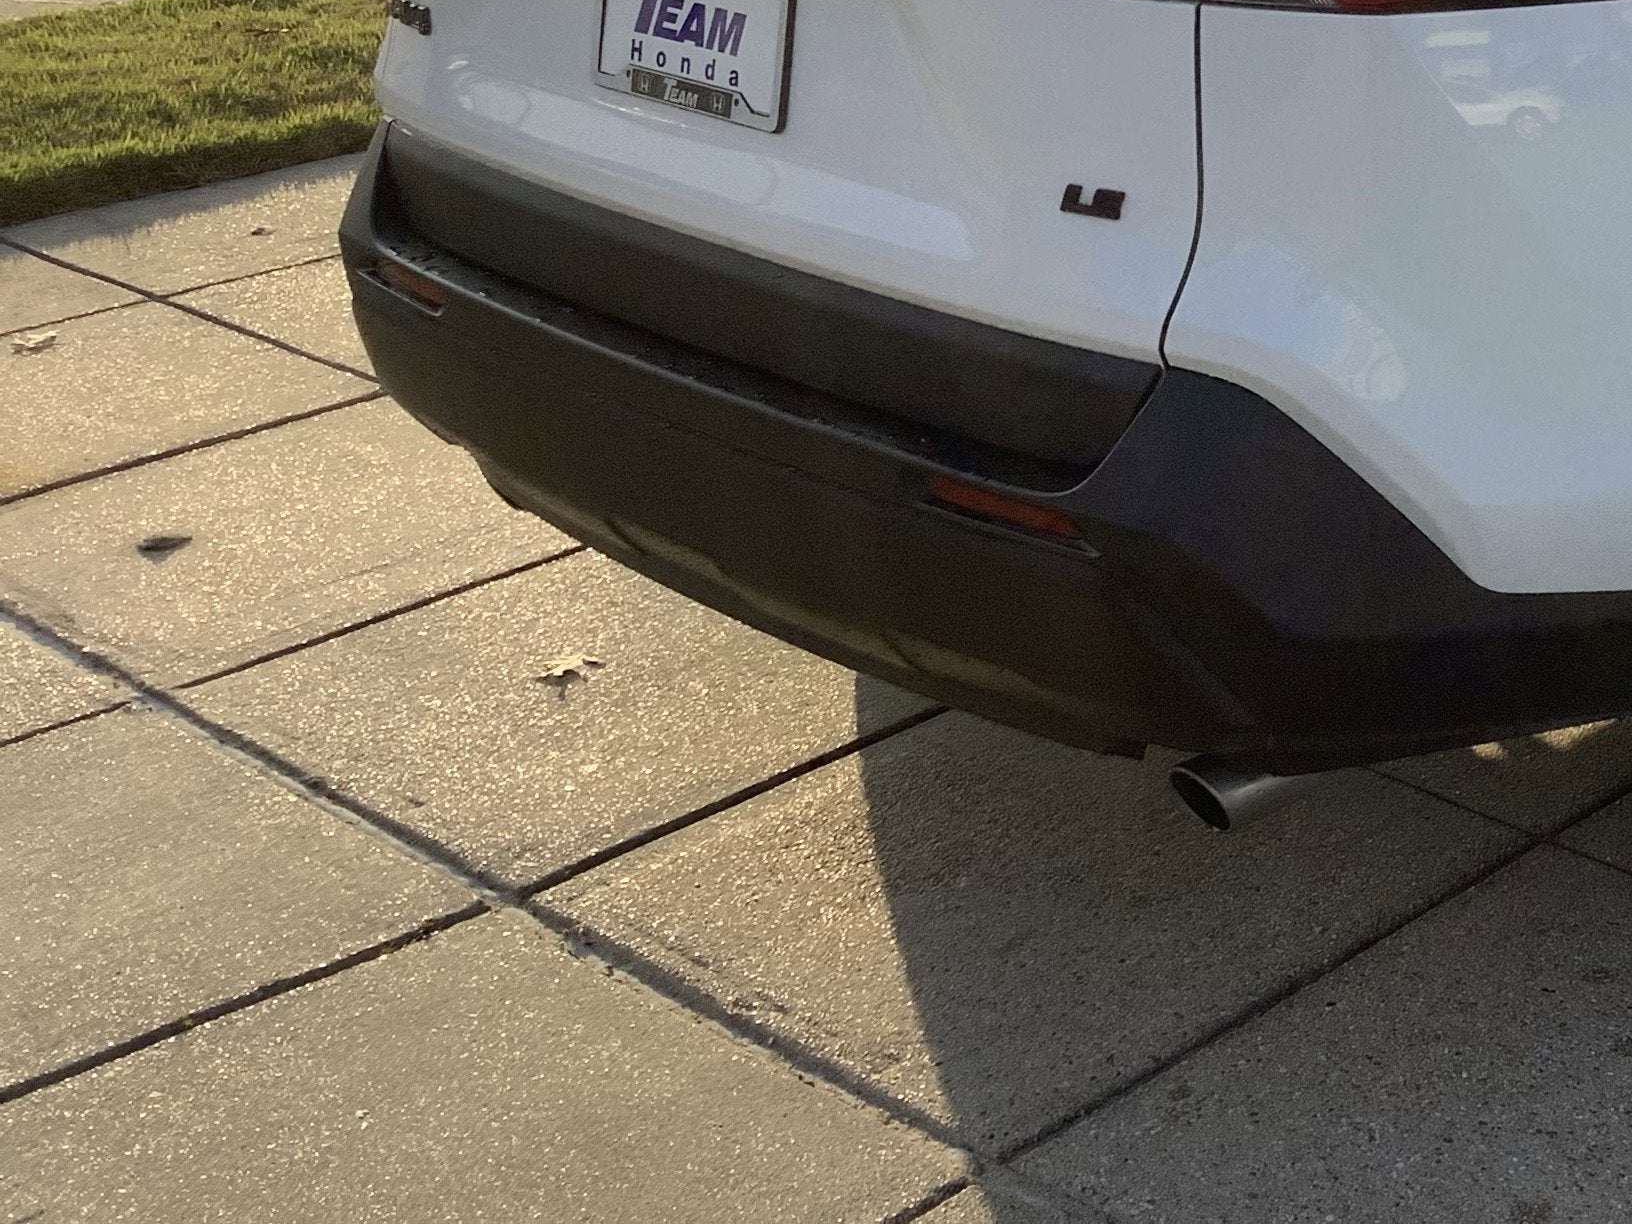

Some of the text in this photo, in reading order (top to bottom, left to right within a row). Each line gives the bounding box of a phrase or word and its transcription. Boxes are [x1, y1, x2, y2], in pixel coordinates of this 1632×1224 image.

[630, 38, 739, 87] Honda
[663, 78, 699, 108] TEAM
[1060, 183, 1126, 220] LE
